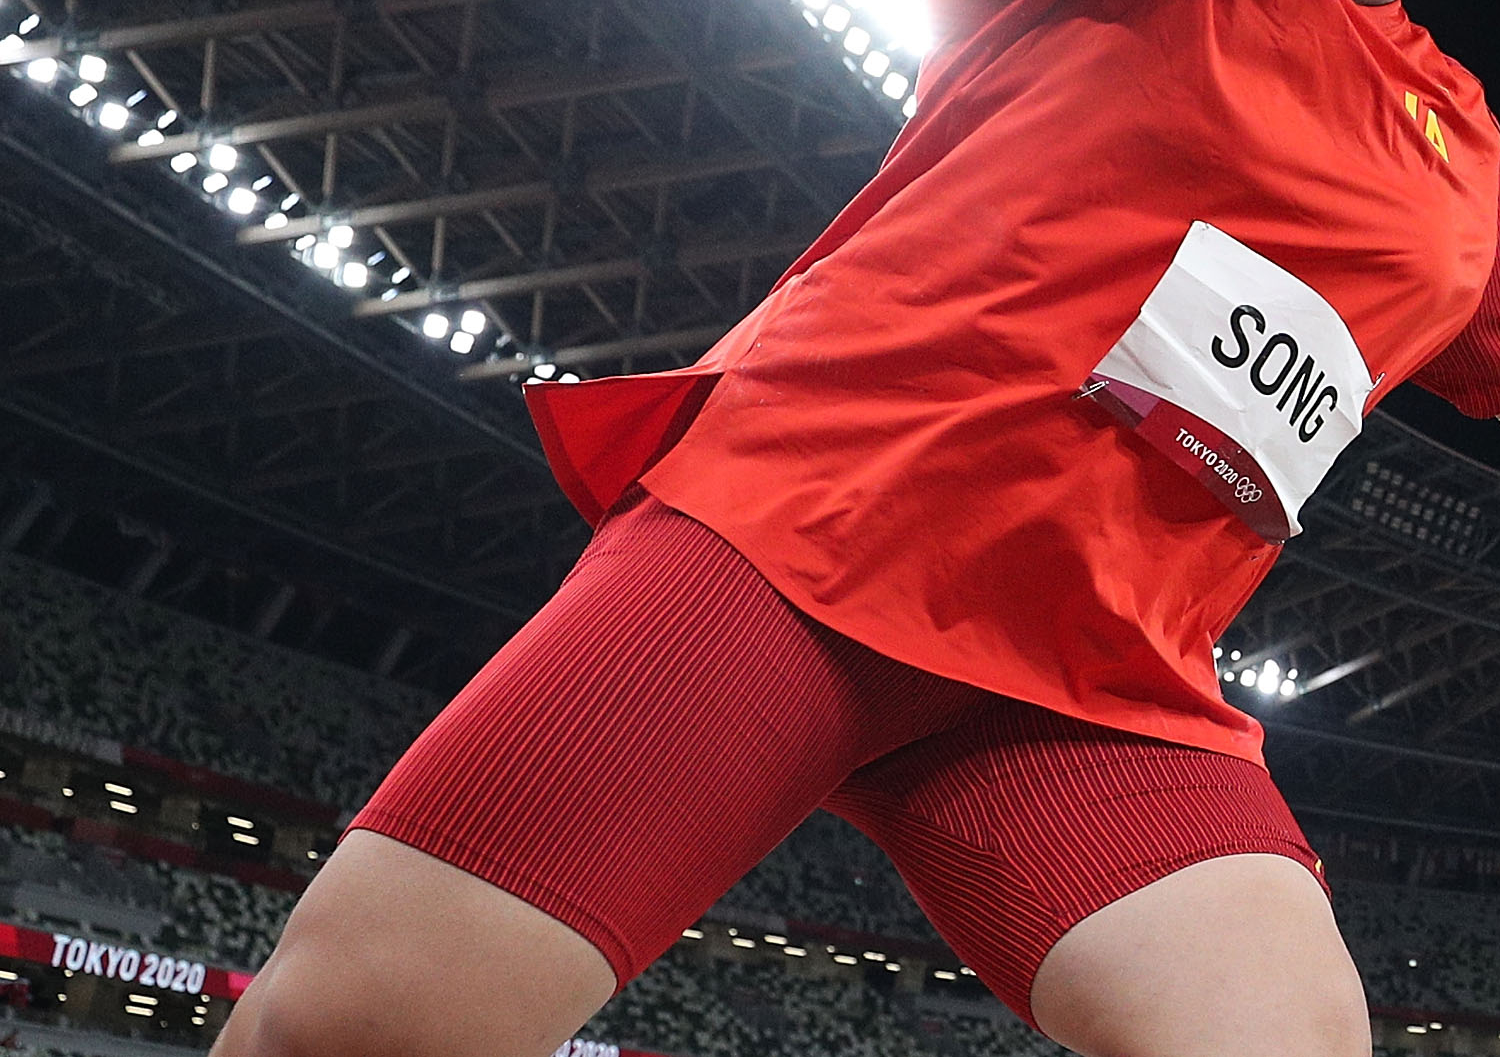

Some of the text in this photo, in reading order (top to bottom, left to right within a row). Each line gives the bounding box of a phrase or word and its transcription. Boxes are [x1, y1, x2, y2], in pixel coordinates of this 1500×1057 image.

[1211, 304, 1338, 443] SONG
[1176, 428, 1239, 485] TOKYO 2020
[52, 934, 206, 994] TOKYO 2020
